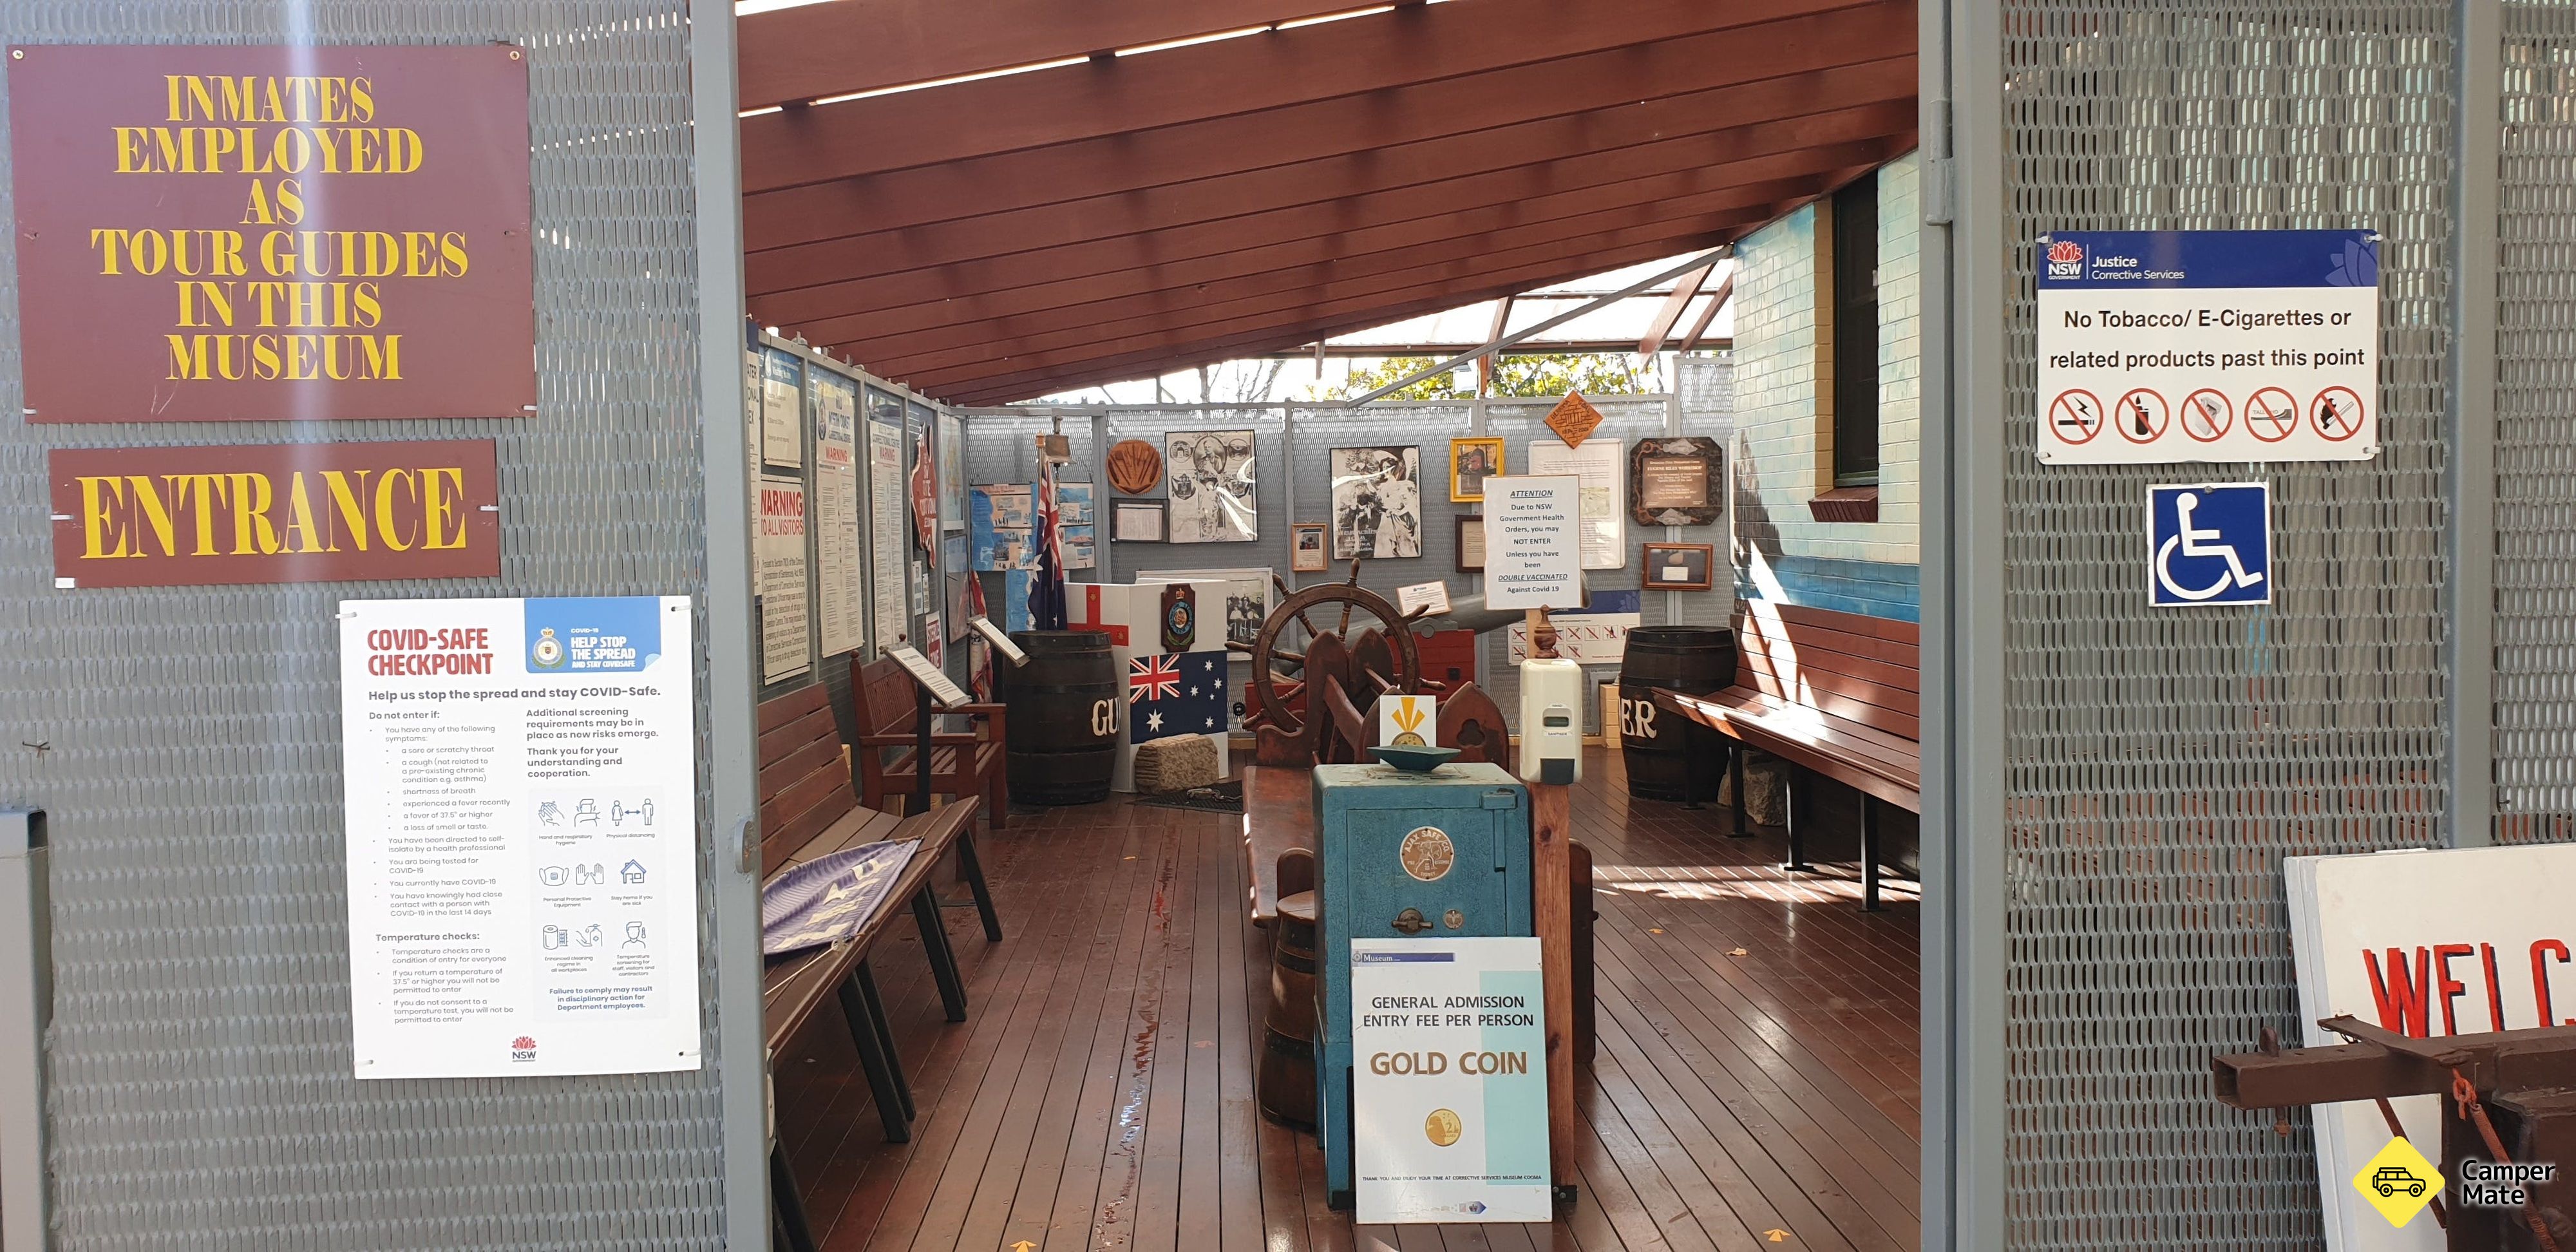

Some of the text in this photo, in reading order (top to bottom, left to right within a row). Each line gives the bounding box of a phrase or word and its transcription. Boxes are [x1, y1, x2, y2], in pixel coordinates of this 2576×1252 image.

[164, 75, 375, 122] INMATES
[111, 127, 423, 174] EMPLOYED
[240, 178, 305, 225] AS
[91, 229, 469, 278] TOUR GUIDES
[2092, 256, 2137, 268] Justice
[2049, 263, 2081, 275] NSW
[2092, 269, 2184, 280] Corrective Services
[174, 281, 382, 328] IN THIS
[2065, 308, 2353, 331] No Tobacco/ E-Cigarettes or
[164, 334, 402, 381] MUSEUM
[2050, 348, 2365, 372] related products past this point
[825, 445, 849, 462] WARNING
[879, 446, 895, 462] WARNING
[75, 467, 467, 560] ENTRANCE
[768, 519, 778, 536] ALL
[779, 518, 804, 536] VISITORS
[367, 628, 488, 650] COVID-SAFE
[571, 636, 627, 648] HELP STOP
[572, 648, 636, 660] THE SPREAD
[368, 653, 493, 676] CHECKPOINT
[369, 690, 397, 703] Help
[419, 690, 446, 703] stop
[449, 690, 470, 699] the
[473, 688, 518, 702] spread
[521, 688, 545, 697] and
[549, 688, 578, 700] stay
[580, 686, 660, 697] COVID-Safe.
[431, 710, 440, 719] if:
[526, 707, 629, 718] Additional screening
[1092, 697, 1121, 736] GU
[1619, 697, 1657, 739] ER
[461, 725, 495, 734] following
[527, 719, 594, 730] requirements
[596, 720, 618, 729] may
[635, 718, 644, 726] in
[527, 729, 554, 741] place
[592, 729, 616, 738] risks
[618, 730, 658, 739] emerge.
[527, 747, 557, 755] Thank
[560, 748, 578, 757] you
[596, 748, 618, 757] your
[527, 755, 601, 768] understanding
[528, 768, 590, 780] cooperation.
[1405, 833, 1420, 853] AJAX
[1421, 830, 1441, 840] SAFE
[376, 934, 440, 944] Temperature
[1363, 954, 1393, 962] Museum
[584, 987, 612, 995] comply
[565, 995, 608, 1003] disciplinary
[1372, 996, 1524, 1009] GENERAL ADMISSION
[603, 1002, 645, 1010] employees.
[1363, 1014, 1534, 1027] ENTRY FEE PER PERSON
[513, 1051, 536, 1059] NSW
[1370, 1051, 1527, 1076] GOLD COIN
